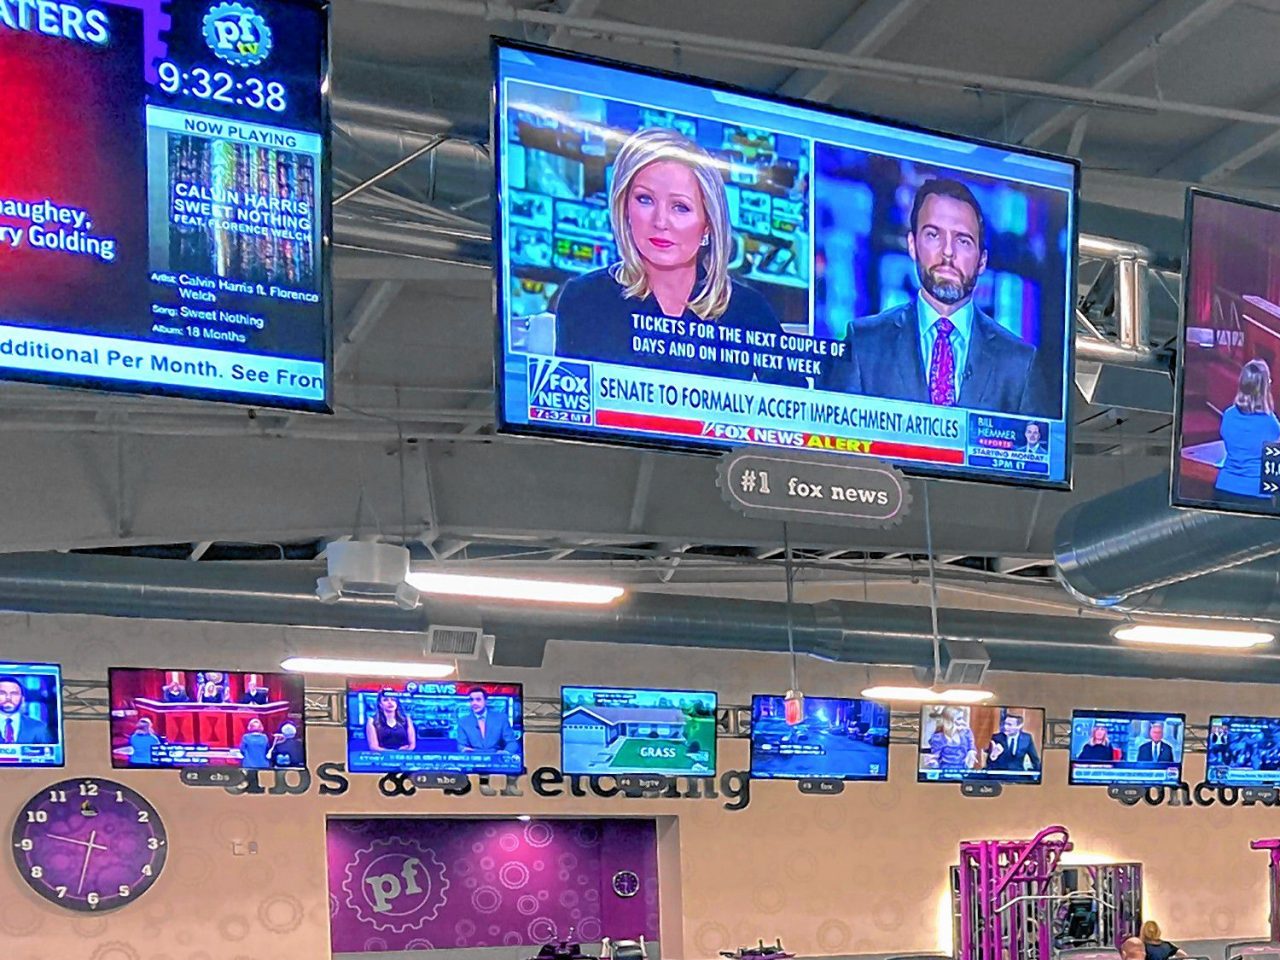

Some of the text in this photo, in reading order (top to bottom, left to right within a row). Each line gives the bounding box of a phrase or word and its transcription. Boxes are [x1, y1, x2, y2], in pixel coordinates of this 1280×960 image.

[158, 62, 286, 111] 9:32:38
[184, 119, 297, 147] NOW PLAYING
[175, 183, 308, 214] CALVIN HARRIS
[174, 199, 312, 230] SWEET NOTHING
[208, 220, 268, 236] FLORENCE
[271, 228, 312, 243] WELCH
[29, 226, 115, 260] Golding
[179, 275, 216, 288] Calvin
[219, 279, 253, 294] Harris
[270, 286, 319, 302] Florence
[179, 288, 216, 302] Welch
[180, 306, 217, 321] Sweet
[220, 311, 264, 329] Nothing
[186, 326, 200, 338] 18
[203, 328, 247, 343] Months
[632, 314, 846, 357] TICKETS FOR THE NEXT COUPLE OF
[632, 338, 821, 375] DAYS AND ON INTO NEXT WEEK
[107, 349, 143, 371] Per
[151, 355, 223, 378] Month.
[231, 364, 269, 383] See
[550, 375, 590, 394] FOX
[538, 391, 590, 411] NEWS
[600, 377, 959, 438] SENATE TO FORMALLY ACCEPT IMPEACHMENT ARTICLES
[536, 408, 568, 421] 7:32
[714, 424, 873, 453] FOX NEWS ALERT
[978, 428, 1016, 440] HEMMER
[1011, 452, 1044, 461] MONDAY
[992, 459, 1013, 469] 3PM
[741, 469, 888, 505] #1 fox news
[419, 684, 456, 694] NEWS
[640, 747, 676, 758] GRASS
[50, 791, 67, 802] 11
[79, 784, 98, 796] 12
[116, 791, 123, 802] 1
[27, 811, 47, 822] 10
[138, 811, 149, 822] 2
[21, 839, 33, 850] 9
[148, 838, 158, 849] 3
[31, 866, 43, 878] 8
[141, 864, 151, 876] 4
[56, 886, 67, 898] 7
[119, 885, 129, 897] 5
[366, 858, 422, 913] pf
[87, 892, 99, 904] 6
